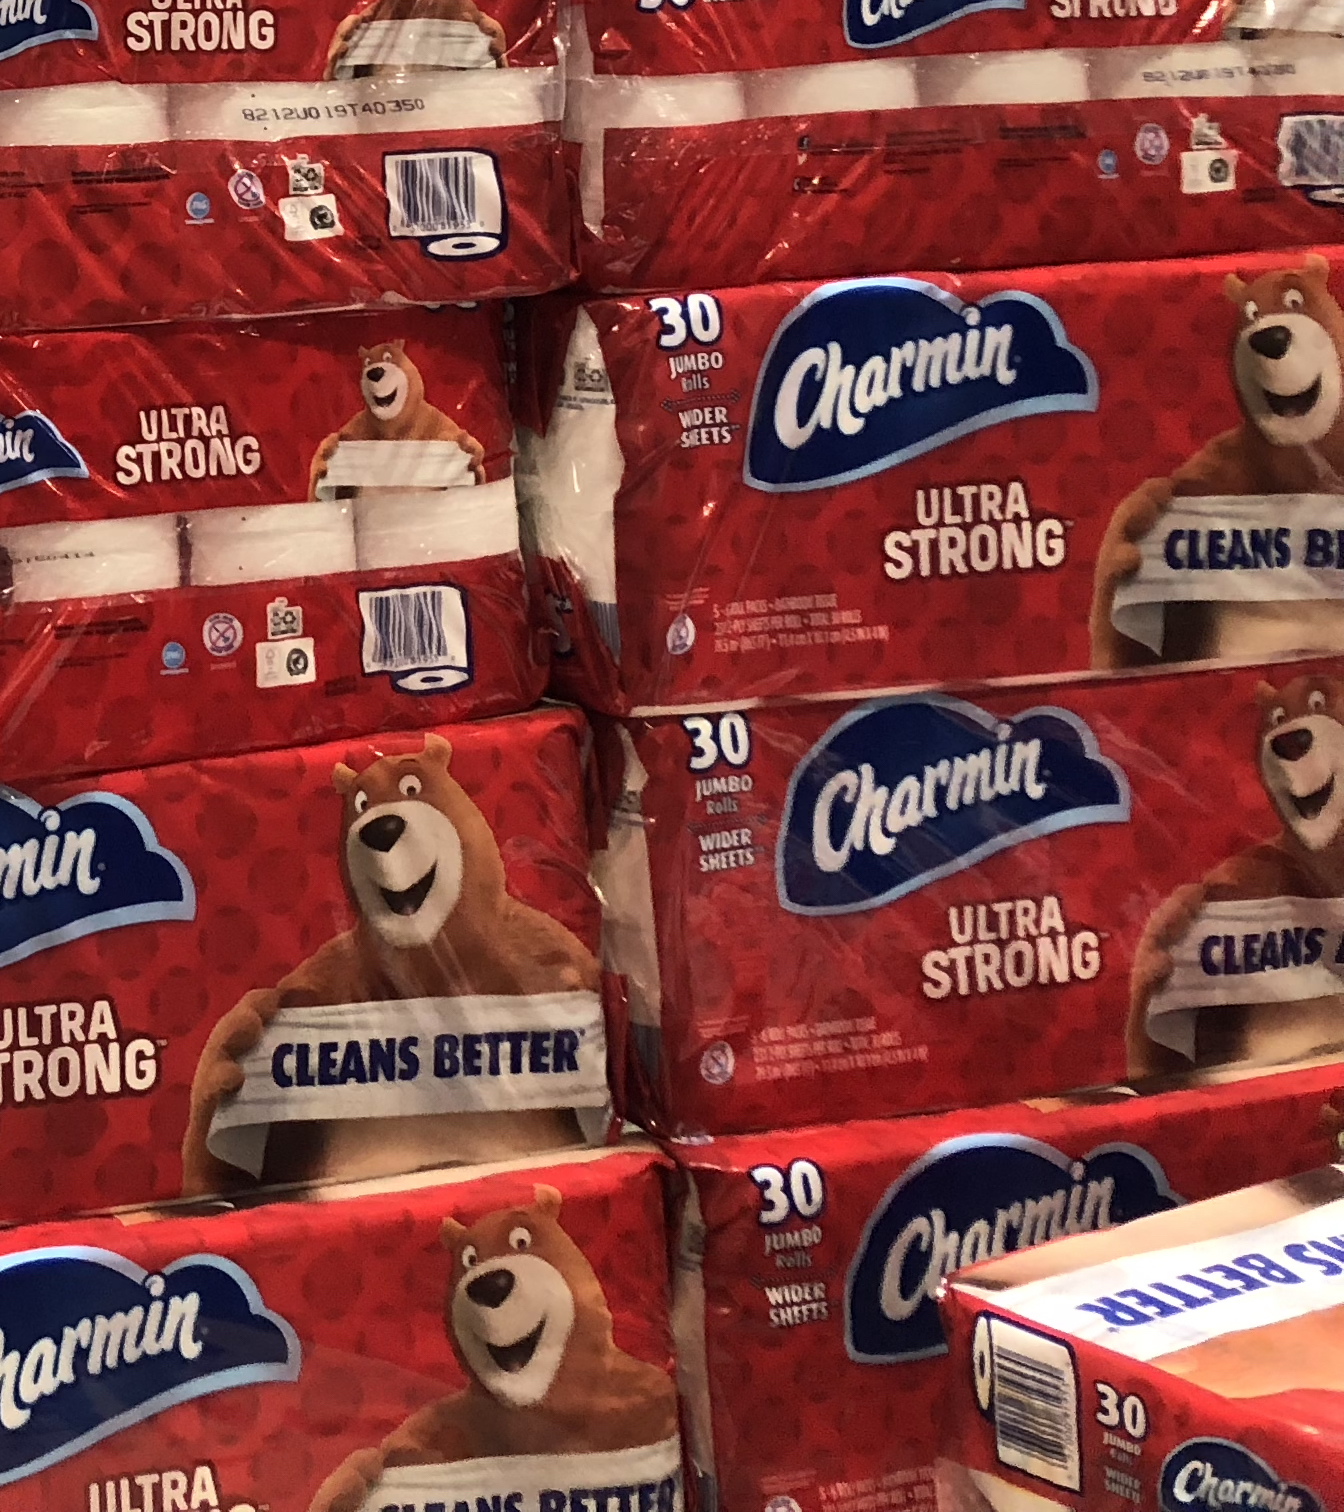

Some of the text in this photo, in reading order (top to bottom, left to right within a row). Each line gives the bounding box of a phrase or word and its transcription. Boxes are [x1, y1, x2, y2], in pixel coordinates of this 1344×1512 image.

[126, 9, 276, 52] STRONG
[269, 1028, 580, 1089] CLEANS BETTER
[1096, 1384, 1147, 1439] 30
